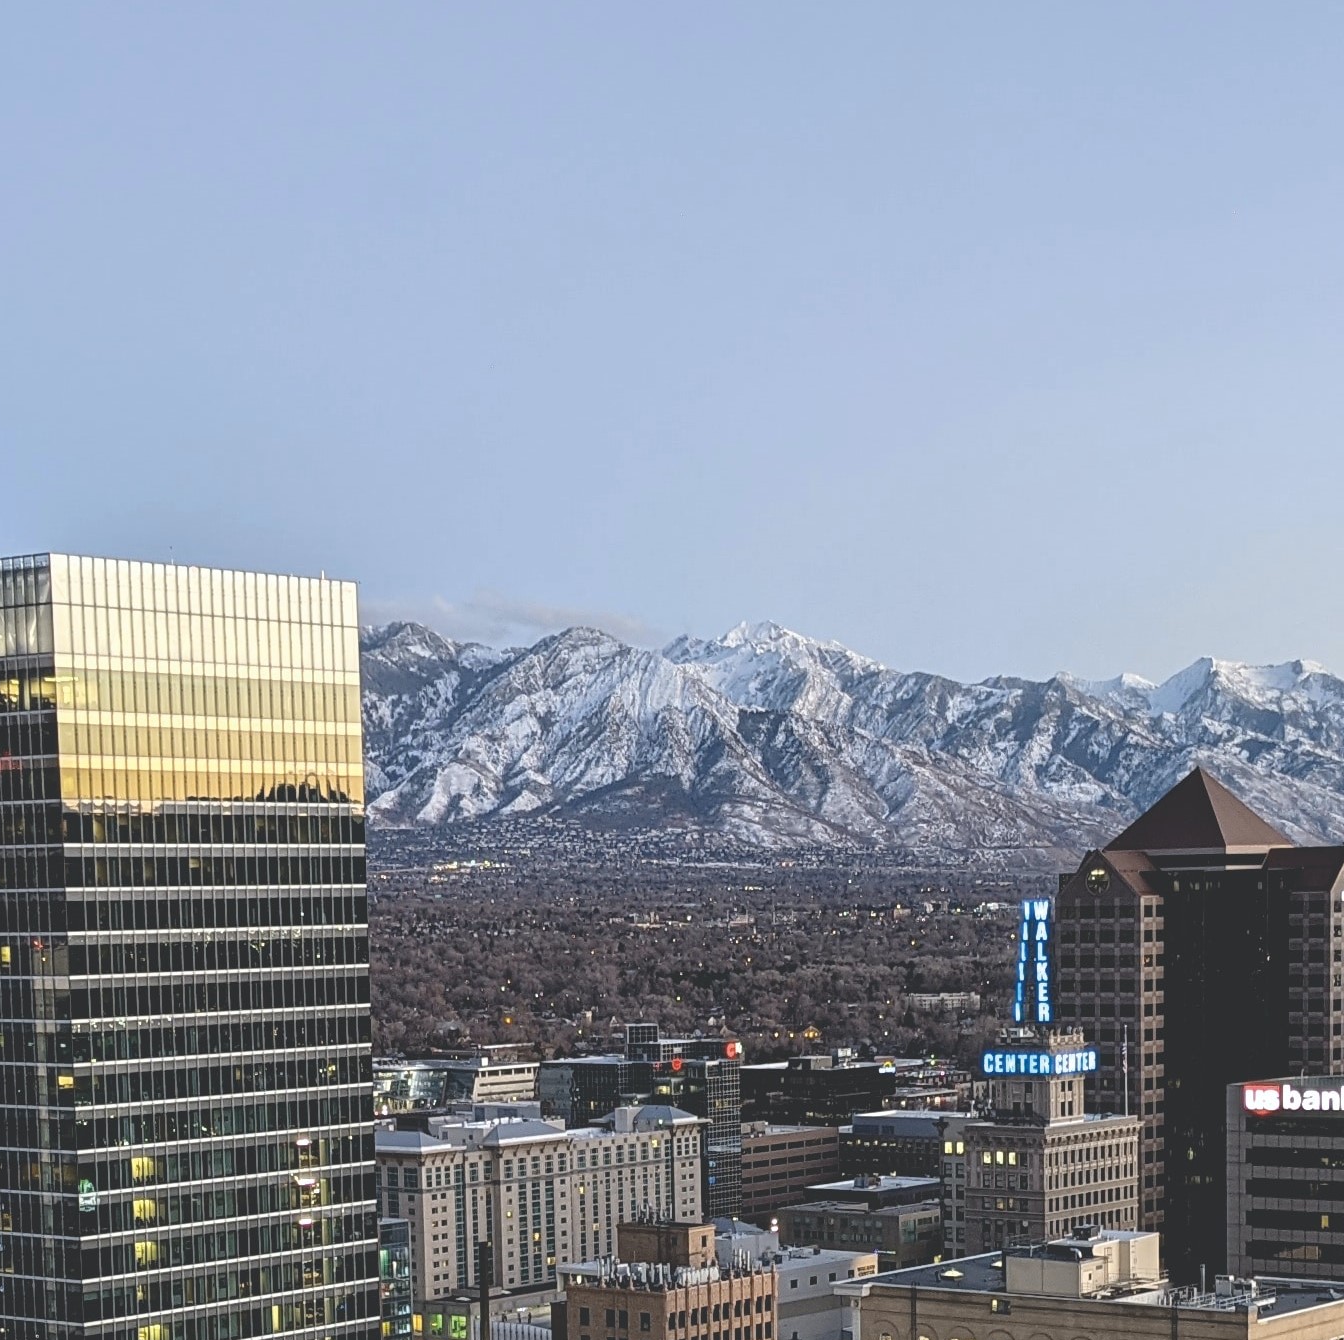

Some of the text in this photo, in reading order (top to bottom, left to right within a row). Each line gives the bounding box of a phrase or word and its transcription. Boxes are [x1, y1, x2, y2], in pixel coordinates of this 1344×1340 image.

[1033, 901, 1050, 1022] WALKER
[983, 1053, 1050, 1074] CENTER
[1054, 1051, 1096, 1075] CENTER
[1245, 1089, 1280, 1111] us
